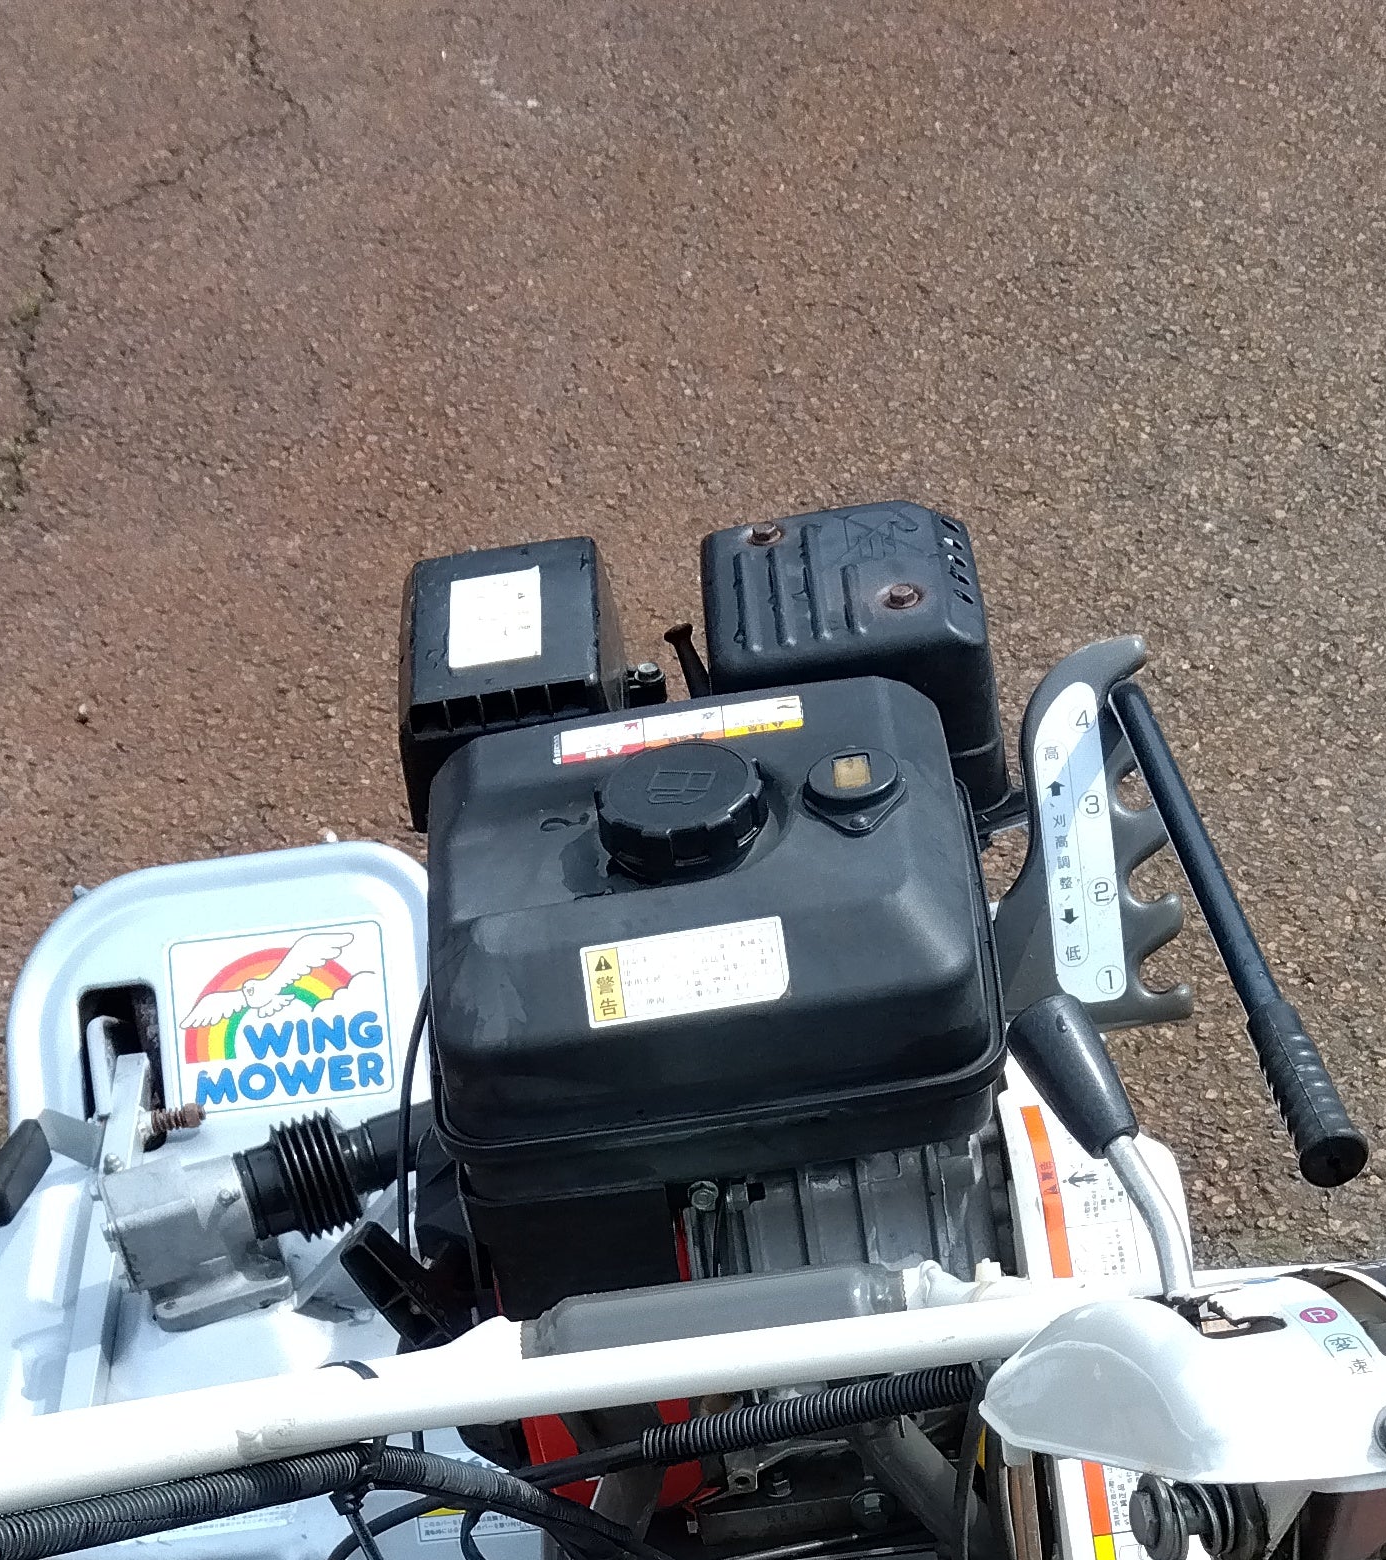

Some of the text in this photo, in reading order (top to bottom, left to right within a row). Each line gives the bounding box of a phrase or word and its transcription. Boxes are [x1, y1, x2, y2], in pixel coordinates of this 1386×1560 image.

[1043, 745, 1082, 962] 高 刈高調整 低
[596, 975, 618, 1017] 警告
[243, 1010, 384, 1060] WING
[195, 1052, 385, 1106] MOWER
[1306, 1309, 1331, 1322] R
[1327, 1336, 1373, 1375] 変速
